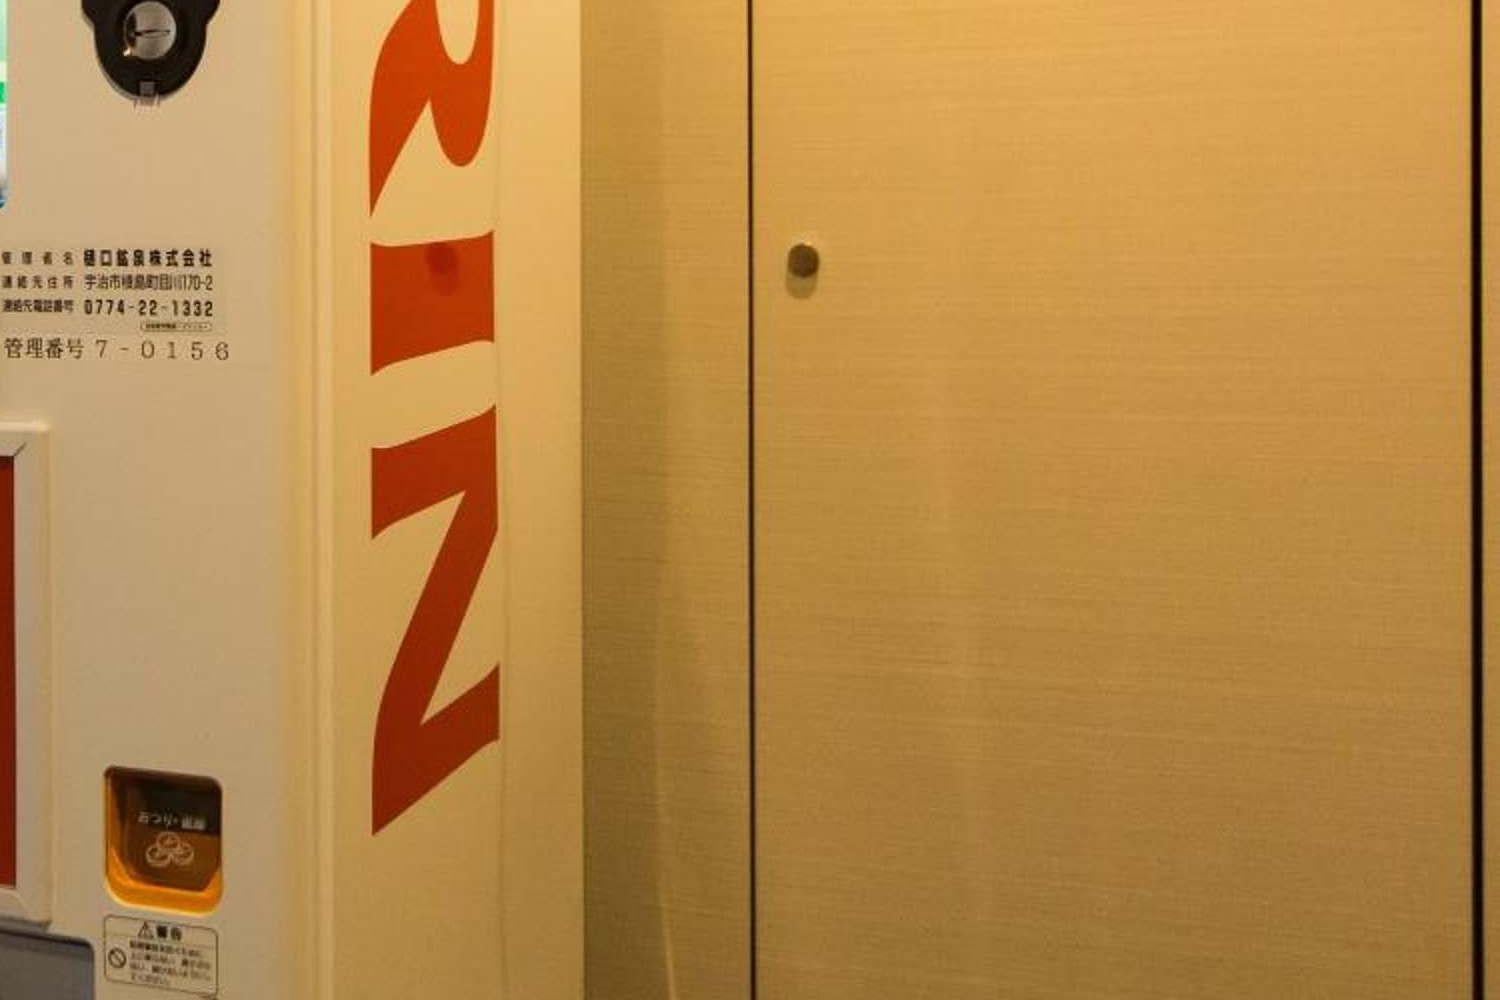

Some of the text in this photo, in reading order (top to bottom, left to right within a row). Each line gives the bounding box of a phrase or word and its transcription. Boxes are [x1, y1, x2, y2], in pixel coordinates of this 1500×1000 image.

[83, 299, 213, 317] 0774-22-1332
[4, 337, 85, 360] 管理番号
